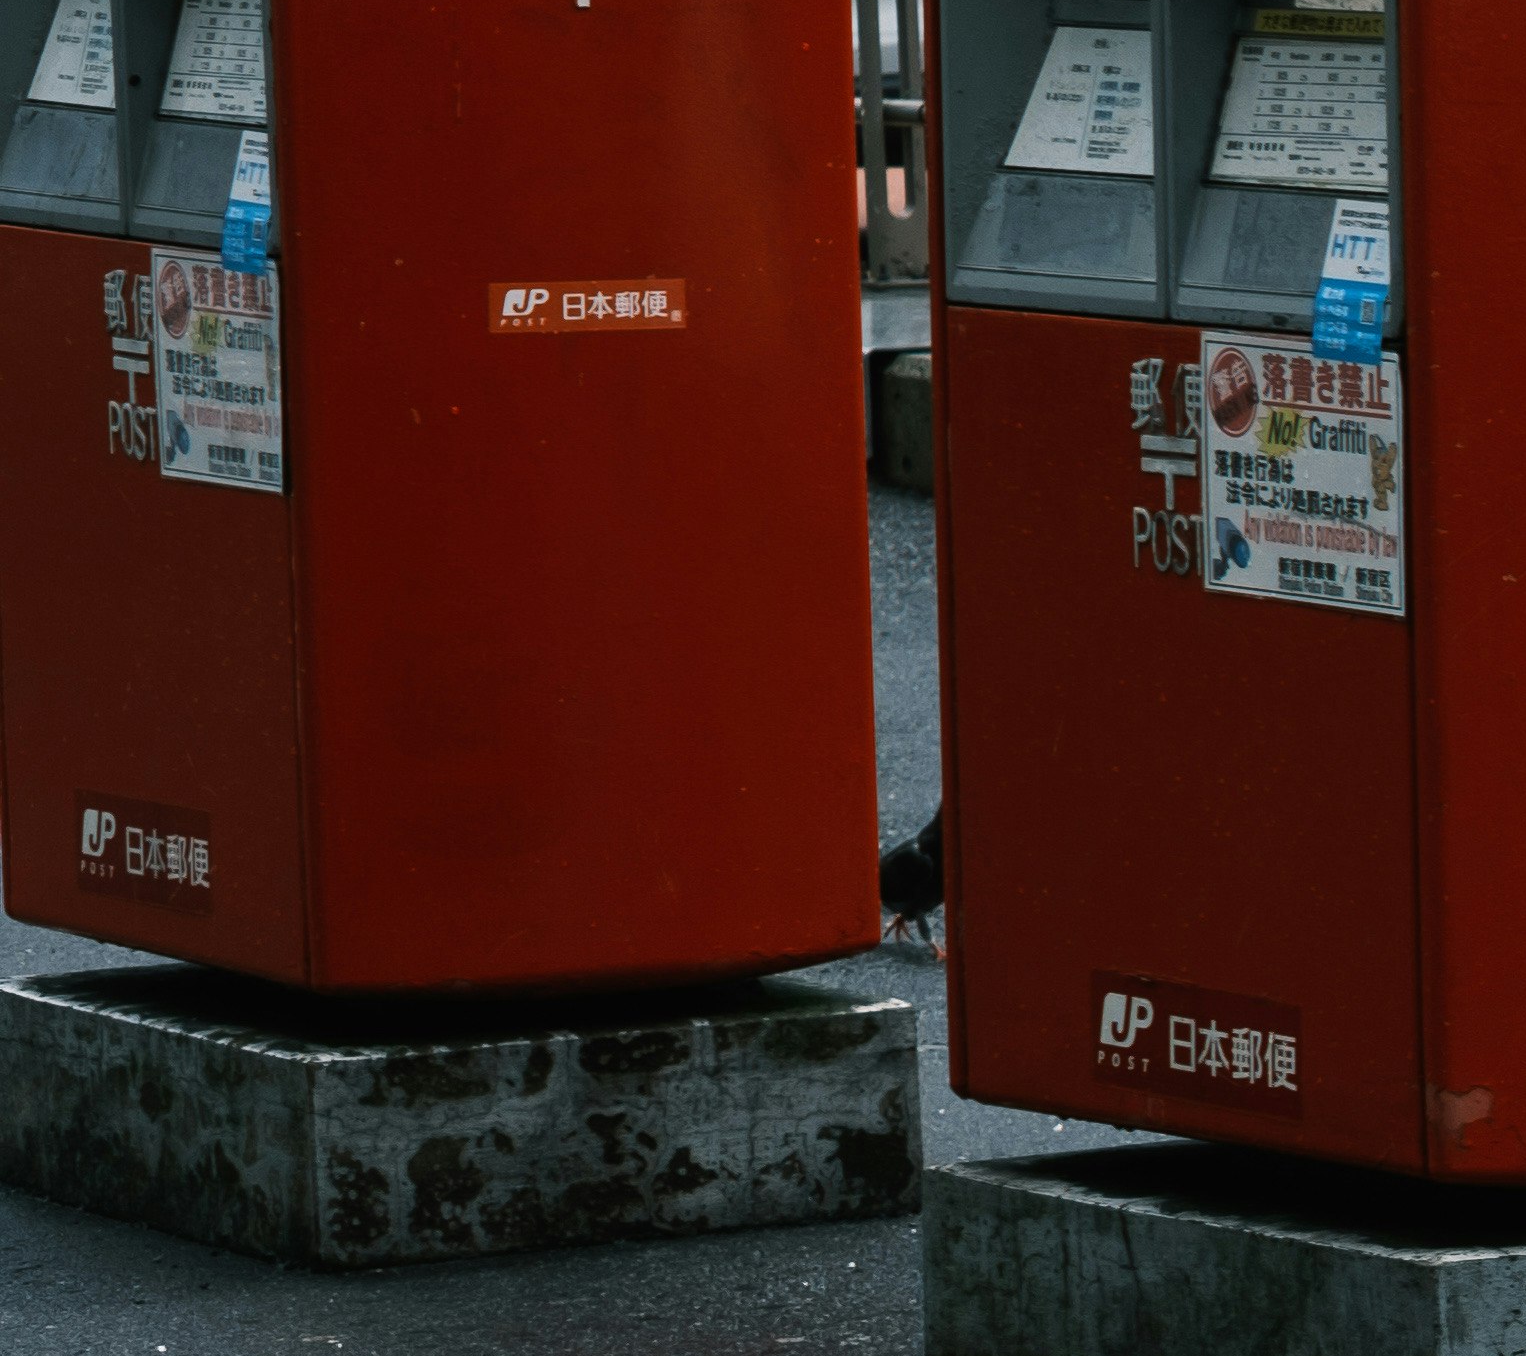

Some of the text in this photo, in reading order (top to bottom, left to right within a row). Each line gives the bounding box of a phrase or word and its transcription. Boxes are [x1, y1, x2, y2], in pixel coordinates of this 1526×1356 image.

[562, 290, 669, 321] 日本郵便
[1261, 353, 1392, 412] 落書き禁止
[1267, 411, 1368, 456] No! Graffiti
[1214, 449, 1296, 485] 落書き行為は
[79, 859, 115, 879] POST
[125, 825, 211, 889] 日本郵便
[1097, 1050, 1151, 1073] POST
[1168, 1013, 1298, 1092] 日本郵便
